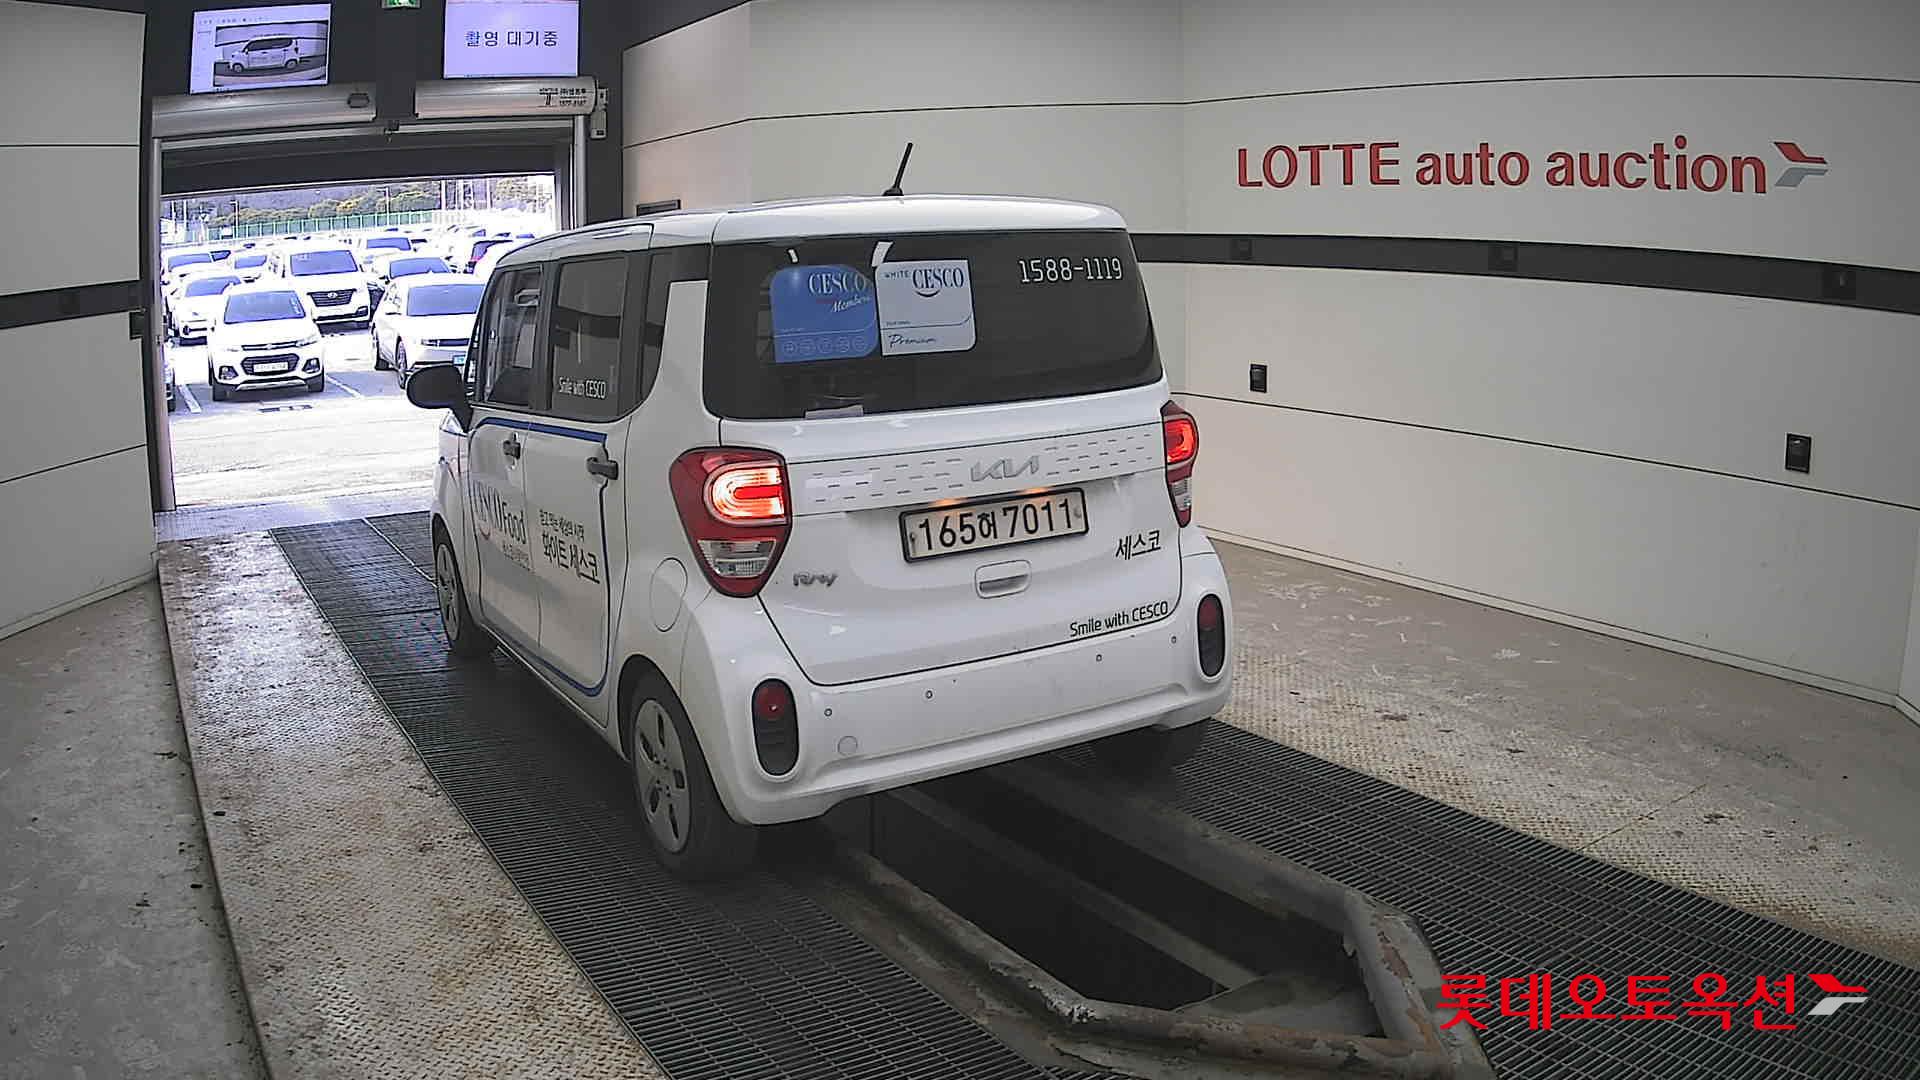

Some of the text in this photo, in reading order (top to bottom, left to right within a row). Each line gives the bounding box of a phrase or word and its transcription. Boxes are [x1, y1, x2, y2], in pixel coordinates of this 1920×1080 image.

[507, 31, 558, 47] 대기중
[1238, 135, 1767, 194] LOTTE auto auction
[808, 272, 866, 295] CESCO
[912, 267, 964, 289] CESCO
[1018, 257, 1124, 284] 1588-1119
[970, 454, 1039, 482] KIA
[1115, 529, 1162, 561] 세스코
[569, 544, 600, 584] 세스코
[1069, 600, 1169, 638] Smile with CESCO
